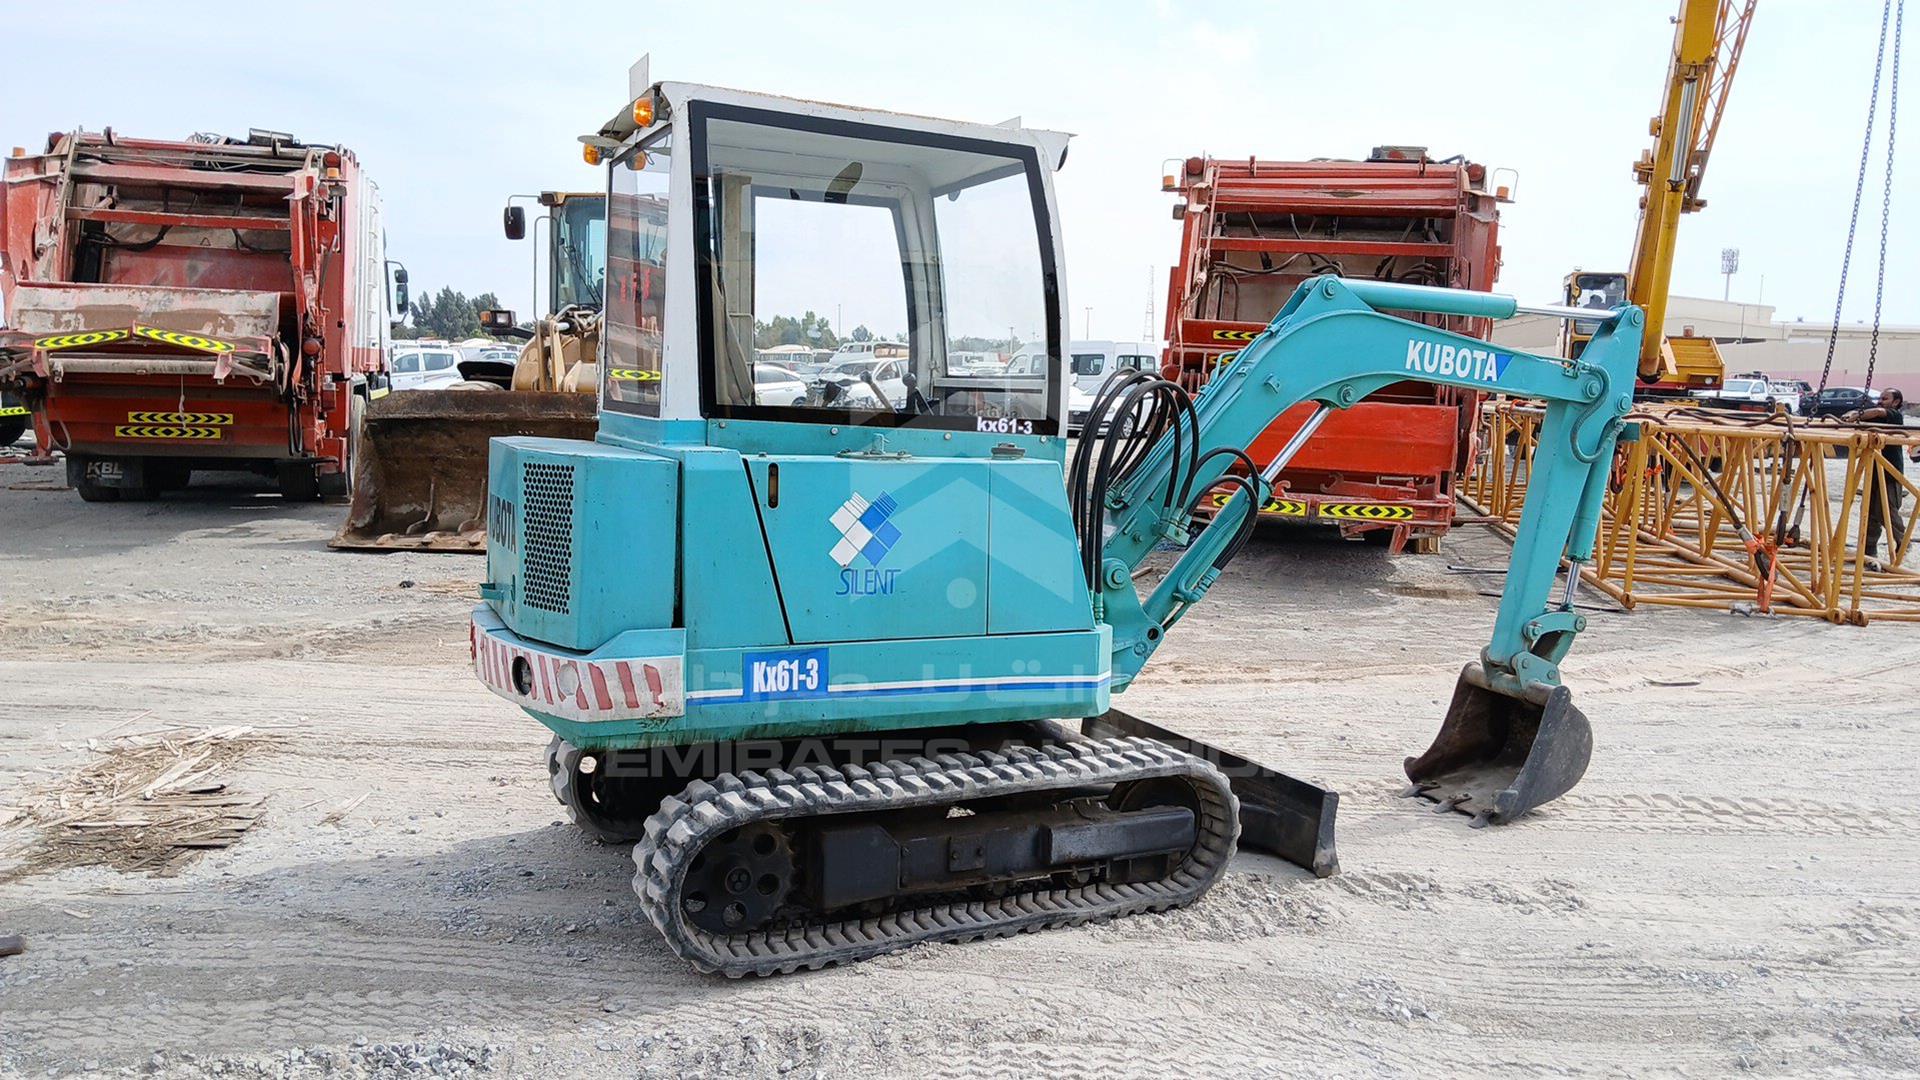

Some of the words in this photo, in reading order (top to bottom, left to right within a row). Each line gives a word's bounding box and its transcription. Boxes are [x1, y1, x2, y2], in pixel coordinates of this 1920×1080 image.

[1405, 339, 1498, 382] KUBOTA
[87, 461, 123, 477] KBL
[489, 494, 516, 554] UBOTA
[836, 568, 901, 595] SILENT
[753, 658, 819, 693] Kx61-3
